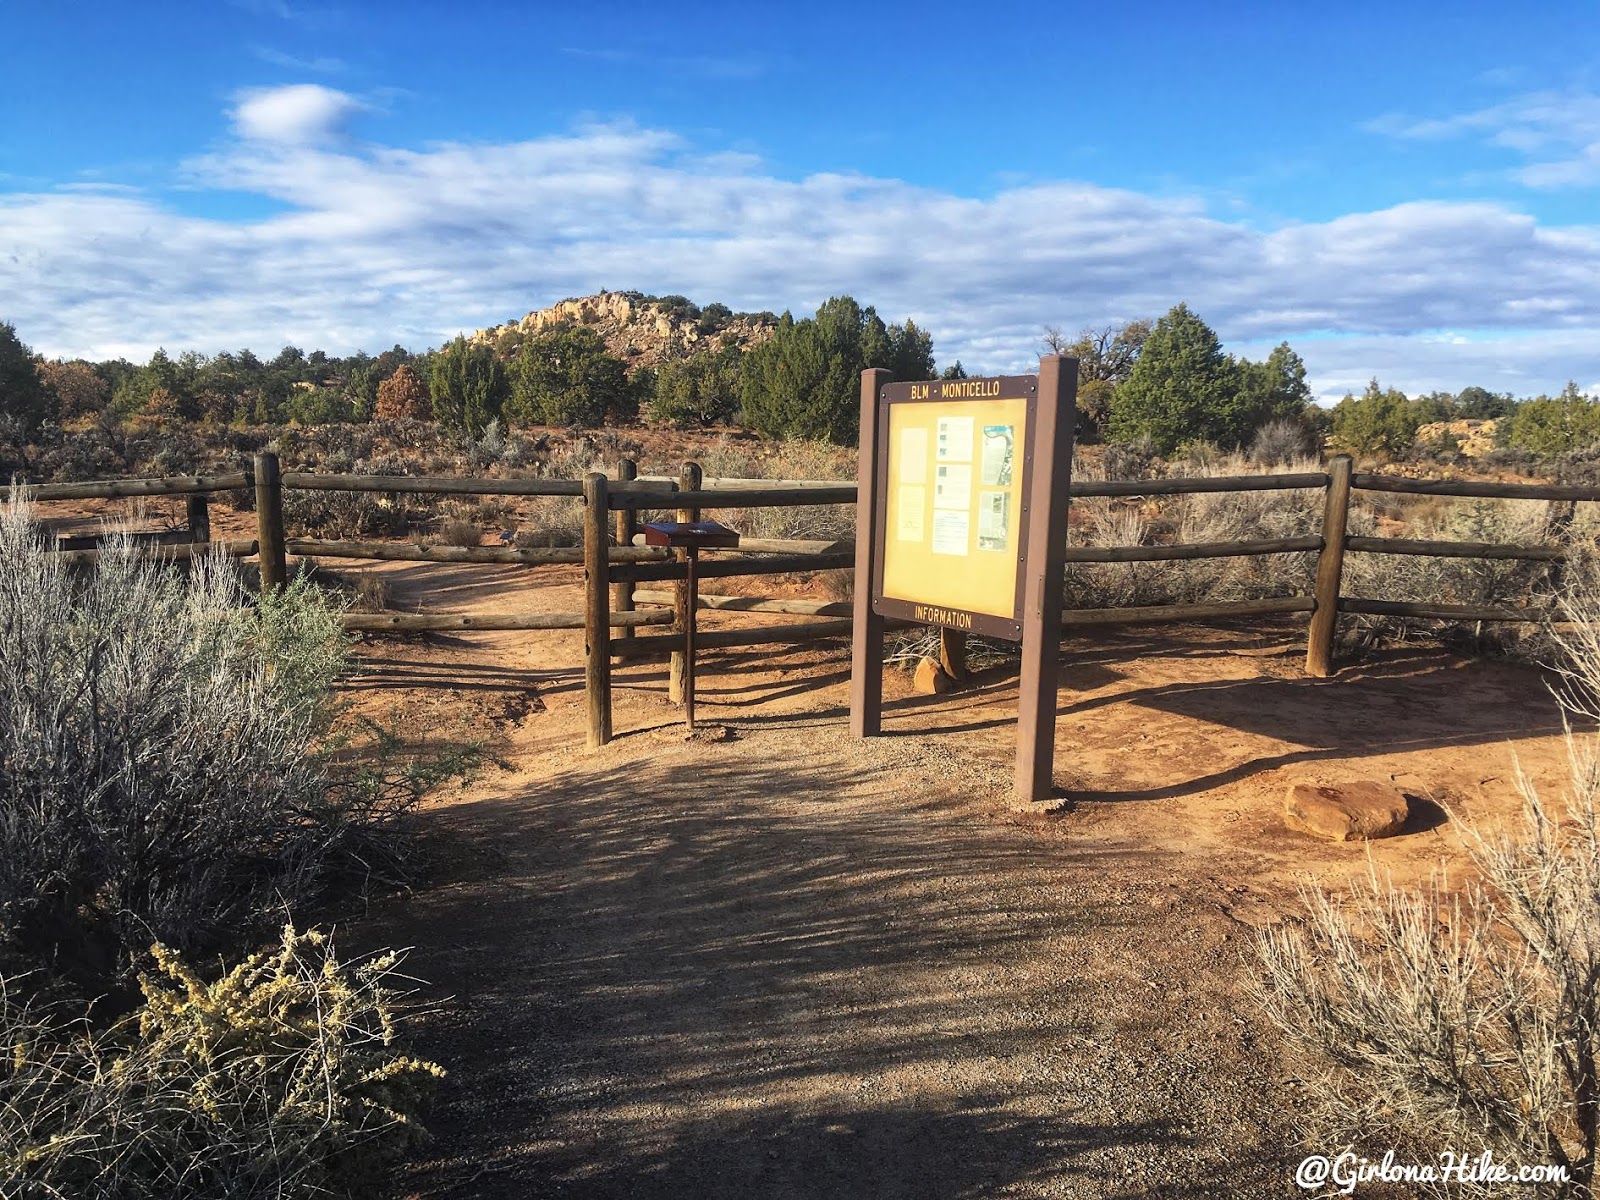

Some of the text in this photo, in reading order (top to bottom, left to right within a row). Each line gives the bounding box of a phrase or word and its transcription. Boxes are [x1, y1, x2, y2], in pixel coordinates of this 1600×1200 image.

[911, 384, 929, 399] BLM
[941, 380, 1000, 398] MONTICELLO
[914, 605, 972, 629] INFORMATION
